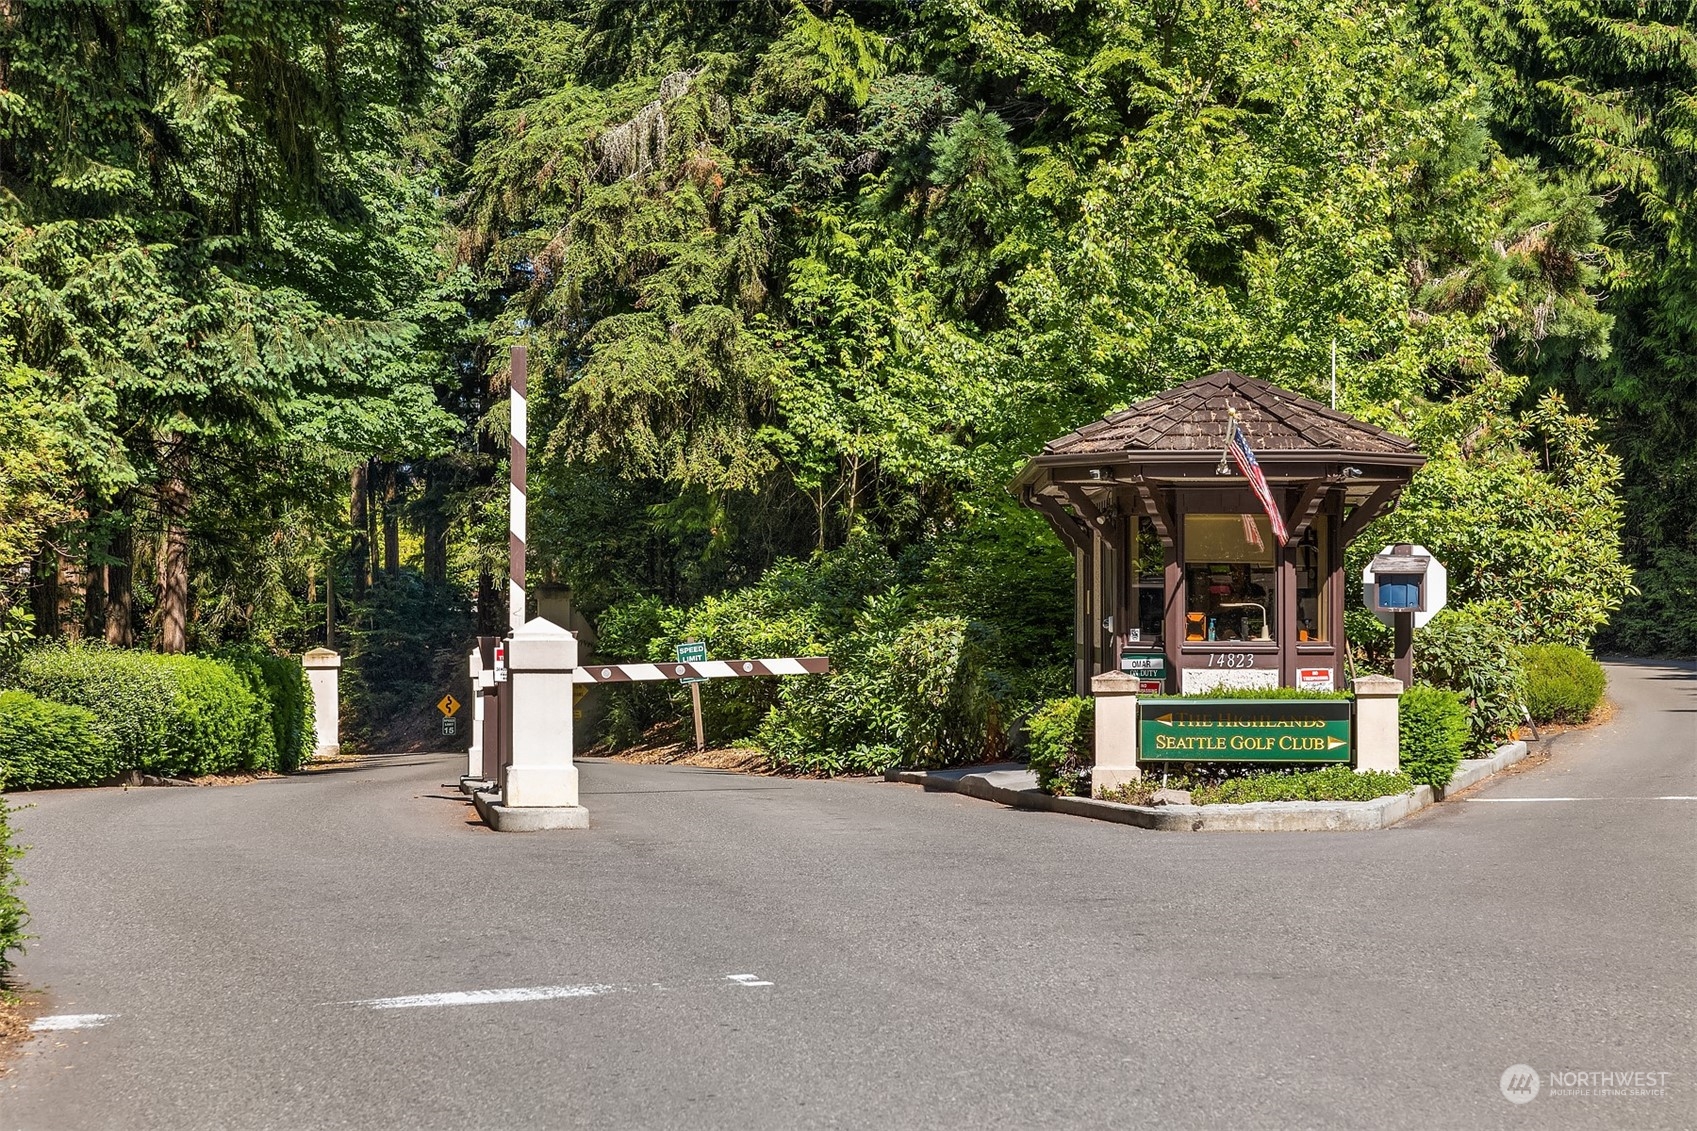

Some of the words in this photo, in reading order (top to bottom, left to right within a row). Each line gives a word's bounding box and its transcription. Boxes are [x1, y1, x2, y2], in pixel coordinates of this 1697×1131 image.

[680, 646, 703, 654] SPEED
[1131, 660, 1151, 668] OMAR
[1208, 653, 1254, 668] 14823
[1129, 669, 1139, 677] ON
[1140, 669, 1158, 677] DUTY
[1175, 711, 1213, 728] THE
[1216, 711, 1326, 729] HIGHLANDS
[1155, 734, 1227, 750] SEATTLE
[1230, 735, 1276, 750] GOLF
[1279, 735, 1325, 751] CLUB
